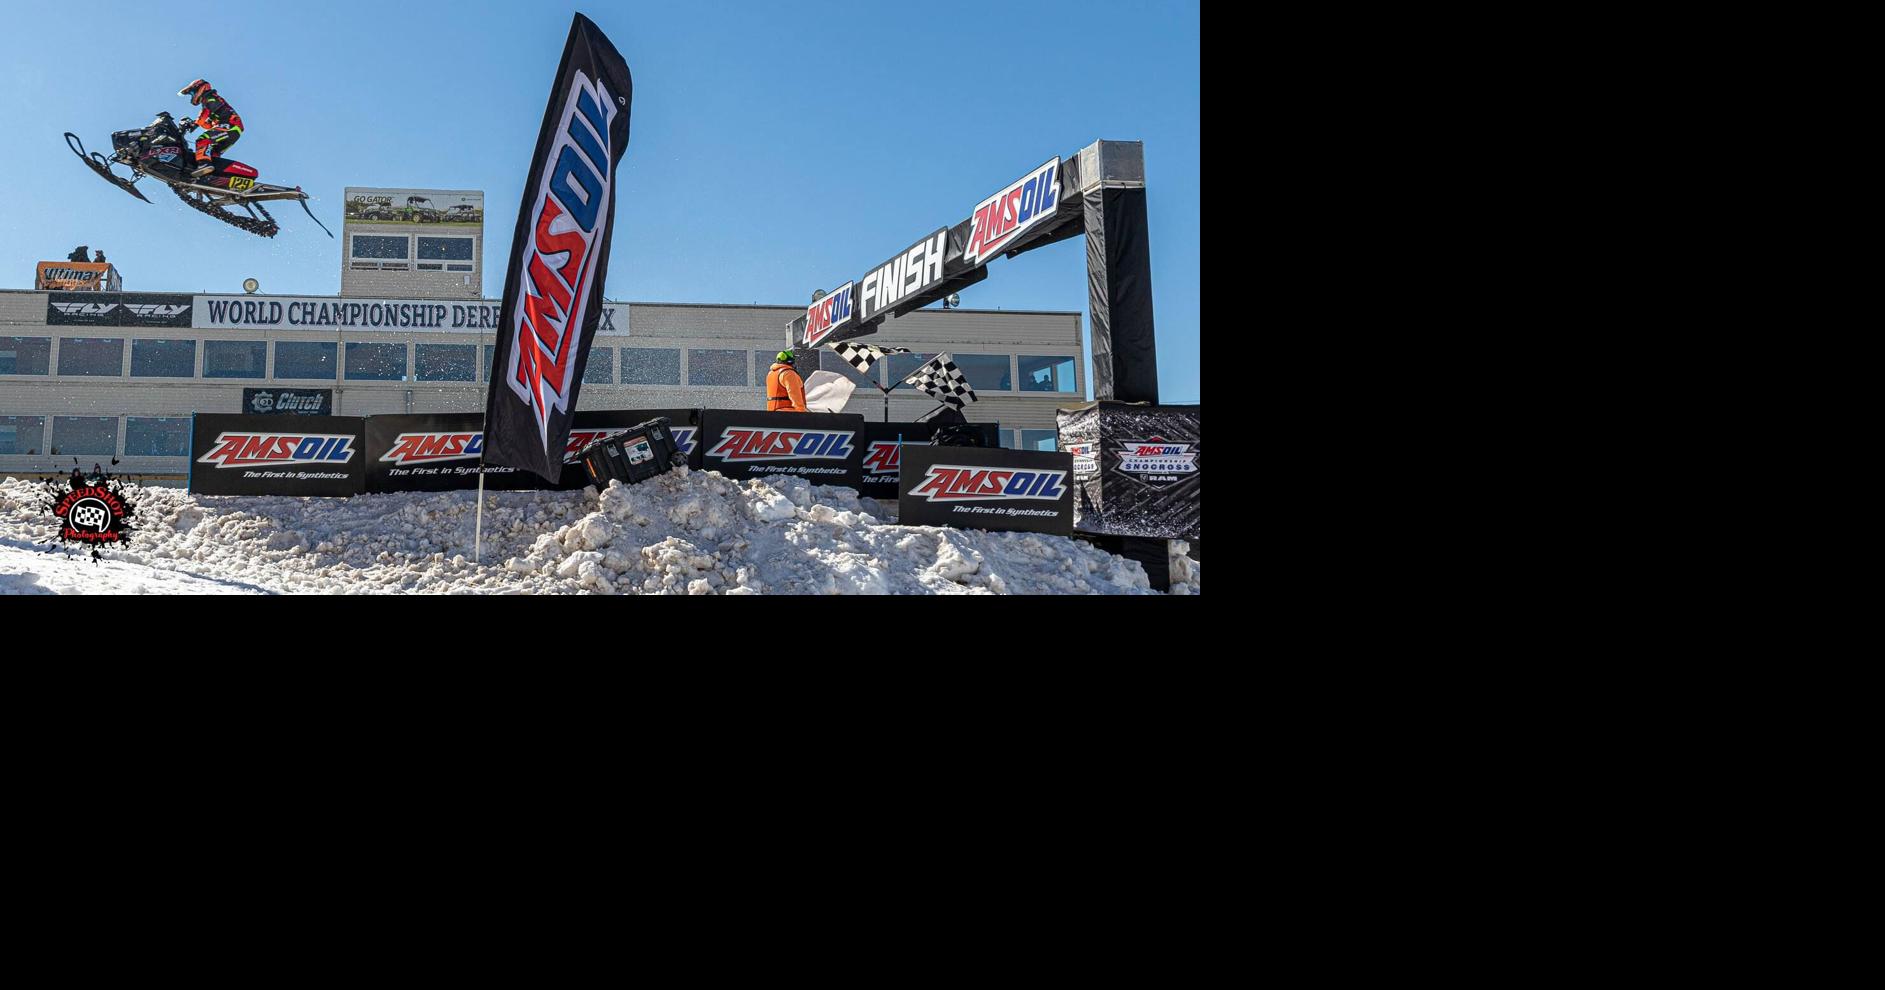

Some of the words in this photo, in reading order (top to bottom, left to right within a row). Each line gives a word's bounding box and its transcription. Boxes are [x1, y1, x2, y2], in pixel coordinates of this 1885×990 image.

[231, 176, 251, 189] 129
[354, 195, 366, 203] GO
[969, 166, 1057, 256] AMSOIL
[515, 82, 610, 428] AMSOIL
[861, 231, 947, 319] FINISH
[51, 302, 119, 313] FLY
[123, 303, 191, 315] FLY
[806, 286, 851, 341] AMSOIL
[208, 300, 282, 325] WORLD
[287, 302, 447, 328] CHAMPIONSHIP
[207, 435, 351, 466] AMSOIL
[714, 430, 851, 460] AMSOIL
[1135, 446, 1182, 457] AMSOIL
[389, 468, 409, 476] The
[411, 467, 438, 475] First
[454, 466, 514, 475] Syntetics
[798, 467, 847, 475] Synthetics
[1125, 463, 1191, 471] SNOCROSS
[297, 472, 350, 480] Synthetics
[919, 468, 1063, 499] AMSOIL
[953, 505, 970, 513] The
[971, 506, 994, 514] First
[1007, 508, 1058, 517] Synthetics
